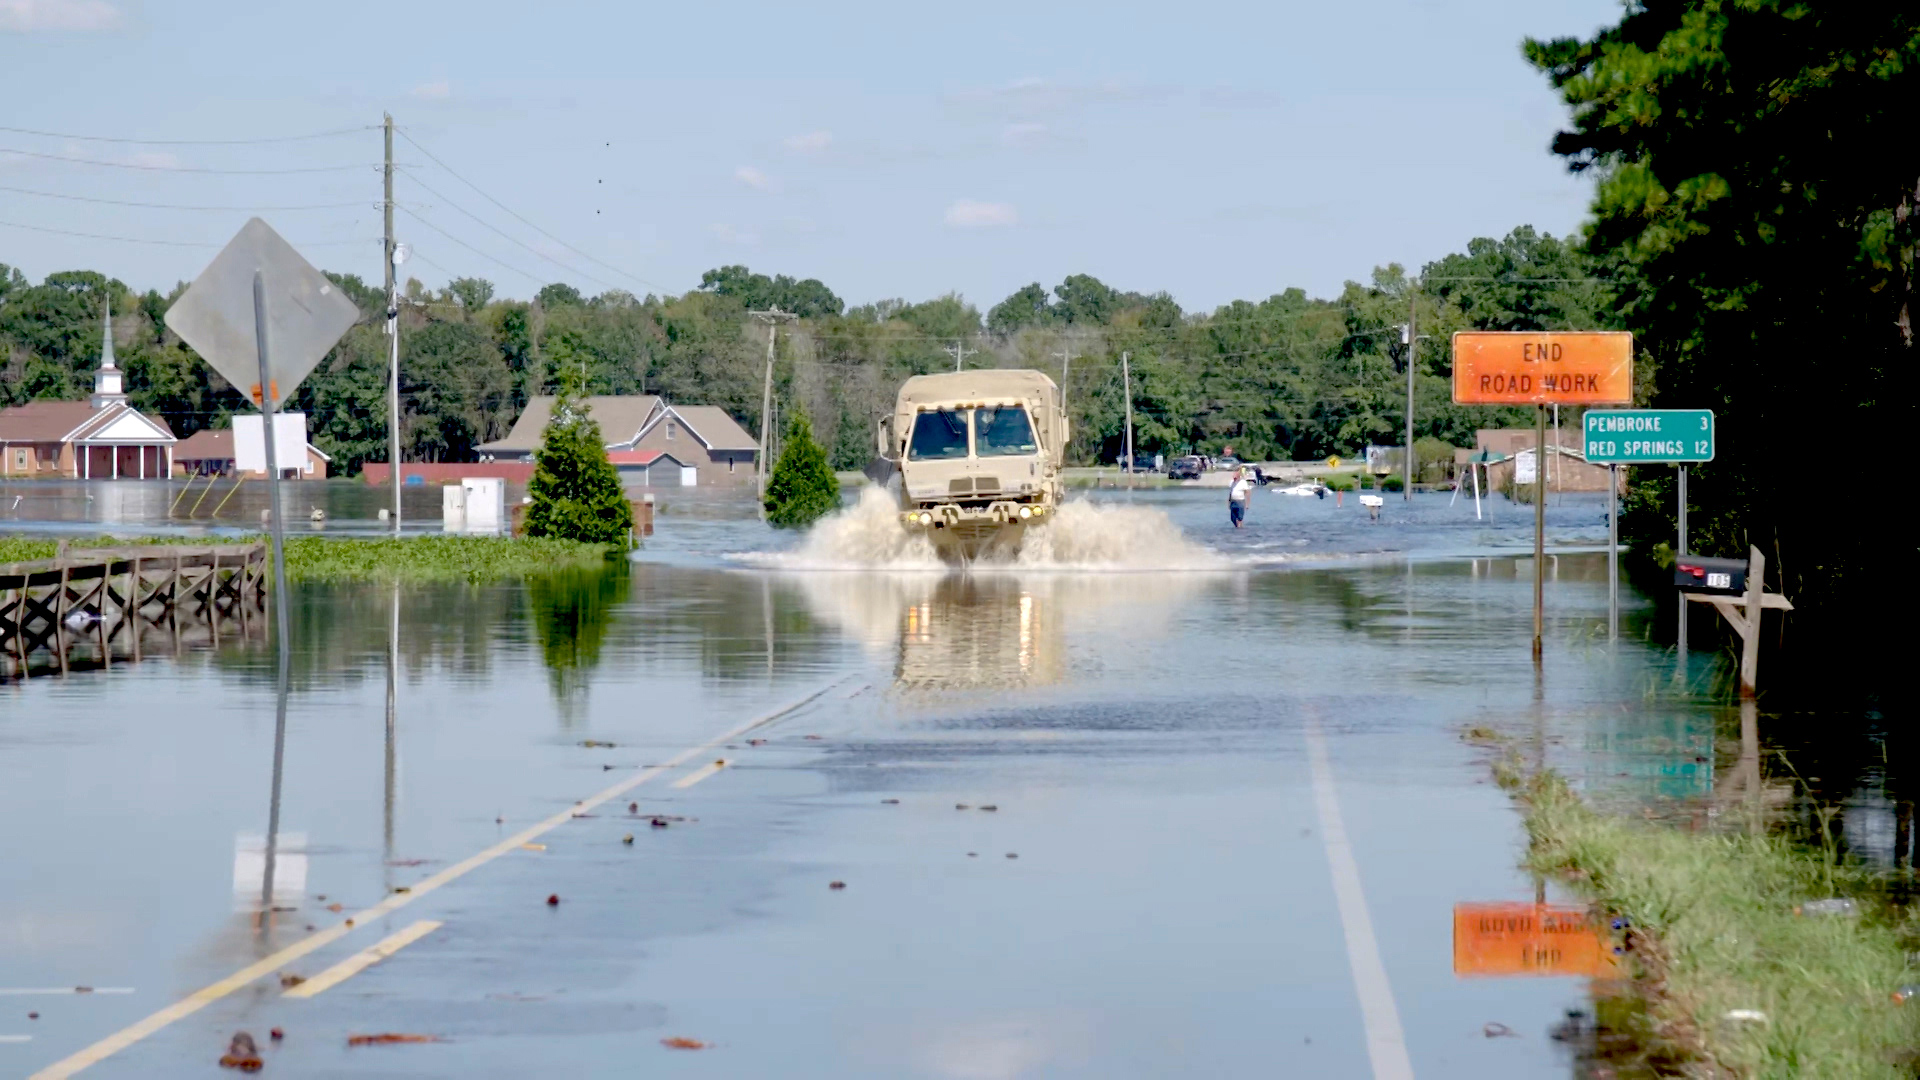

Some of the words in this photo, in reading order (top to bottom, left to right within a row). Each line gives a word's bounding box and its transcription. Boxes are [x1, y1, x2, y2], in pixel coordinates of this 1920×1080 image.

[1523, 343, 1563, 362] END
[1480, 374, 1531, 393] ROAD
[1544, 373, 1599, 393] WORK
[1588, 416, 1662, 432] PEMBROKE
[1700, 416, 1709, 431] 3
[1588, 440, 1616, 456] RED
[1623, 440, 1684, 456] SPRINGS
[1694, 440, 1709, 454] 12
